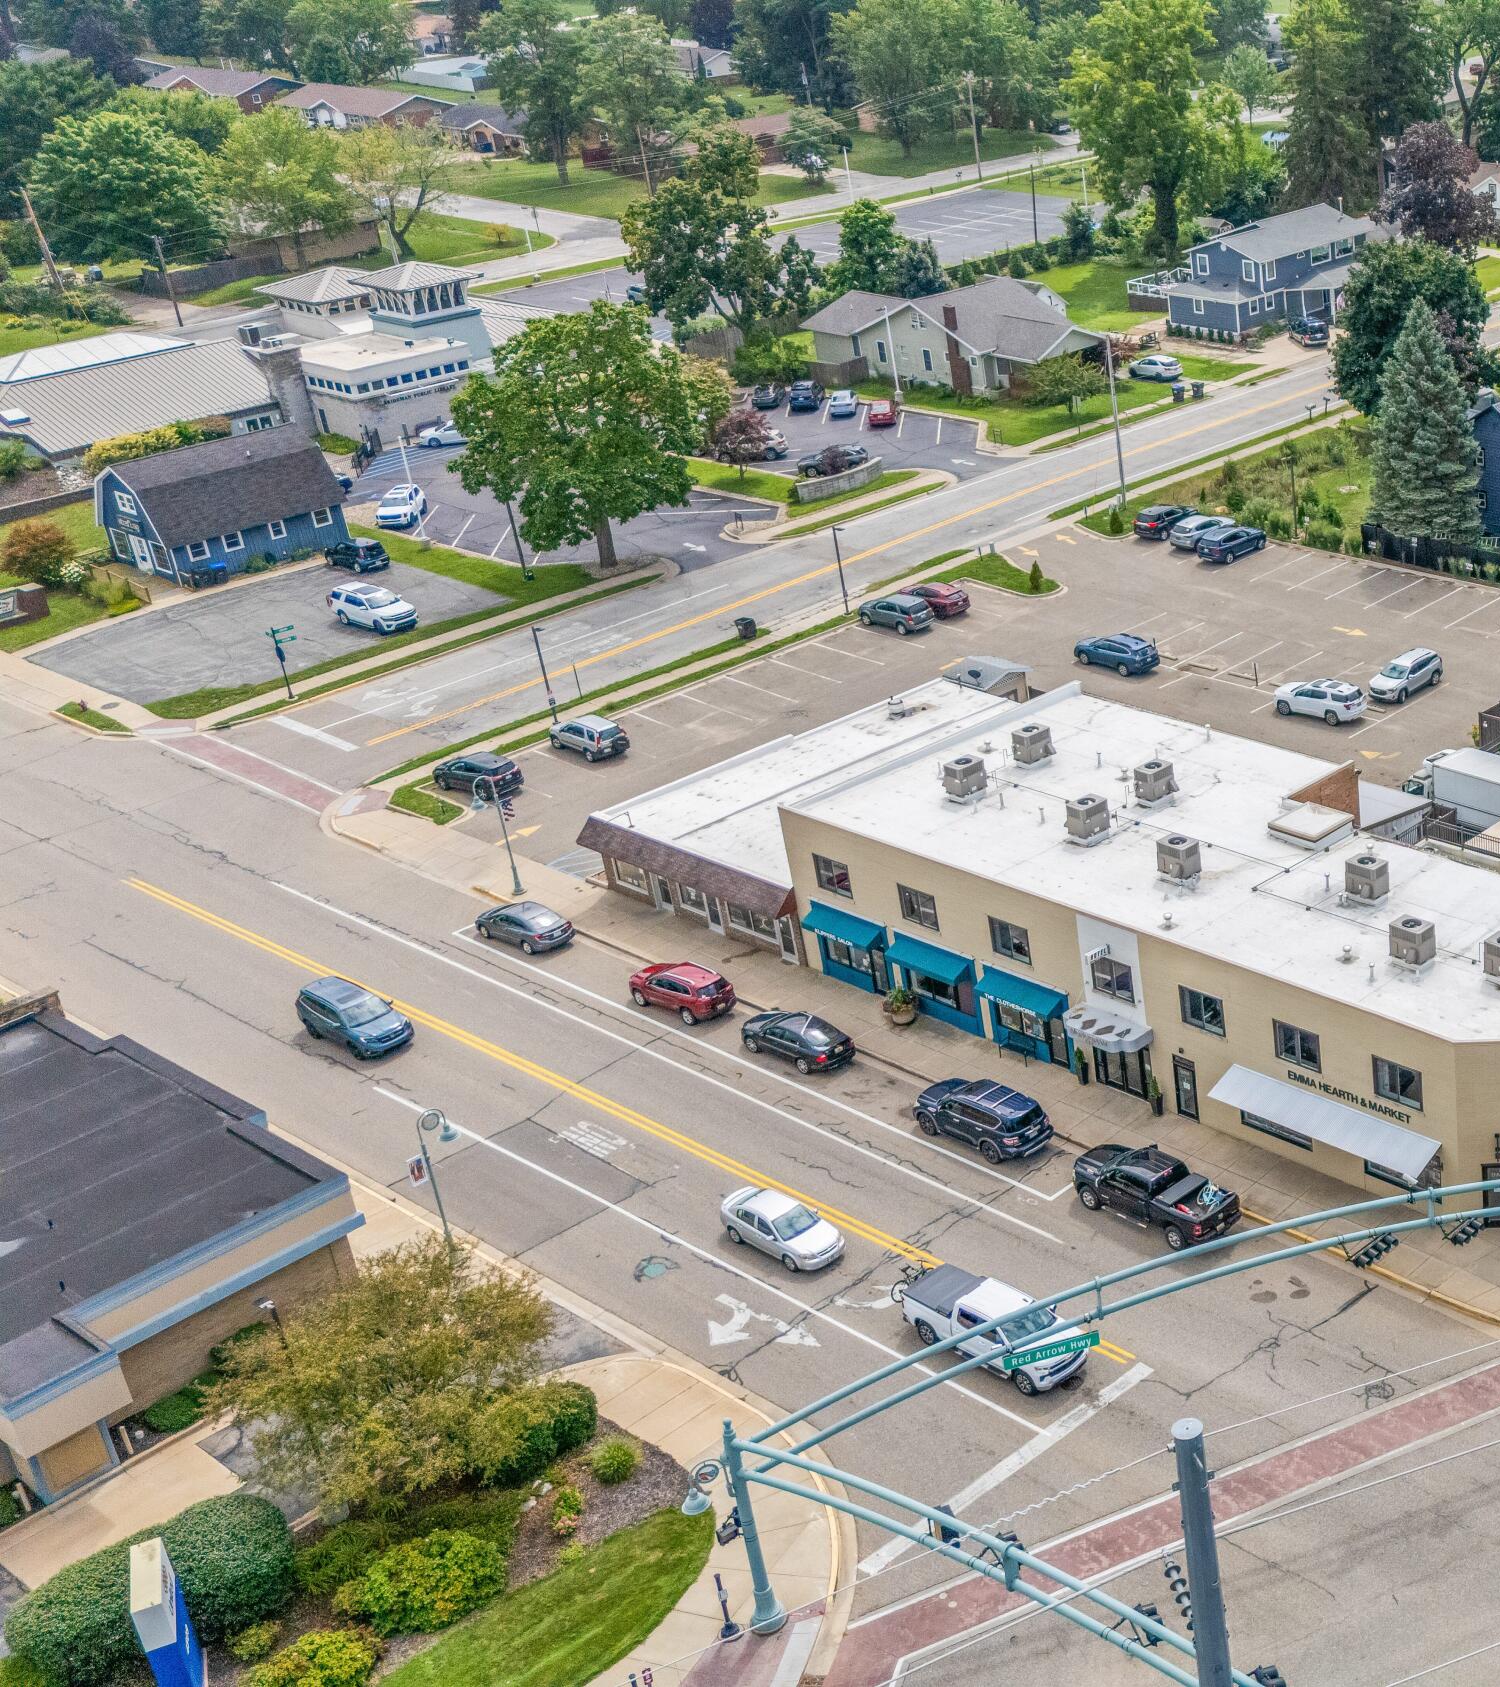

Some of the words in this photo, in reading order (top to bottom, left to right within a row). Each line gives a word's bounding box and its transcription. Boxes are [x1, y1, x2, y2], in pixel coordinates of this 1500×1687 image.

[413, 389, 433, 398] PUBLIC
[434, 384, 456, 393] LIBRARY
[984, 993, 996, 1002] THE
[1287, 1070, 1317, 1089] EMMA
[1318, 1081, 1359, 1105] HEARTH
[1360, 1097, 1368, 1108] &
[1368, 1100, 1412, 1125] MARKET
[1011, 1354, 1031, 1367] Red
[1036, 1345, 1067, 1360] Arrow
[1070, 1337, 1092, 1350] Hwy
